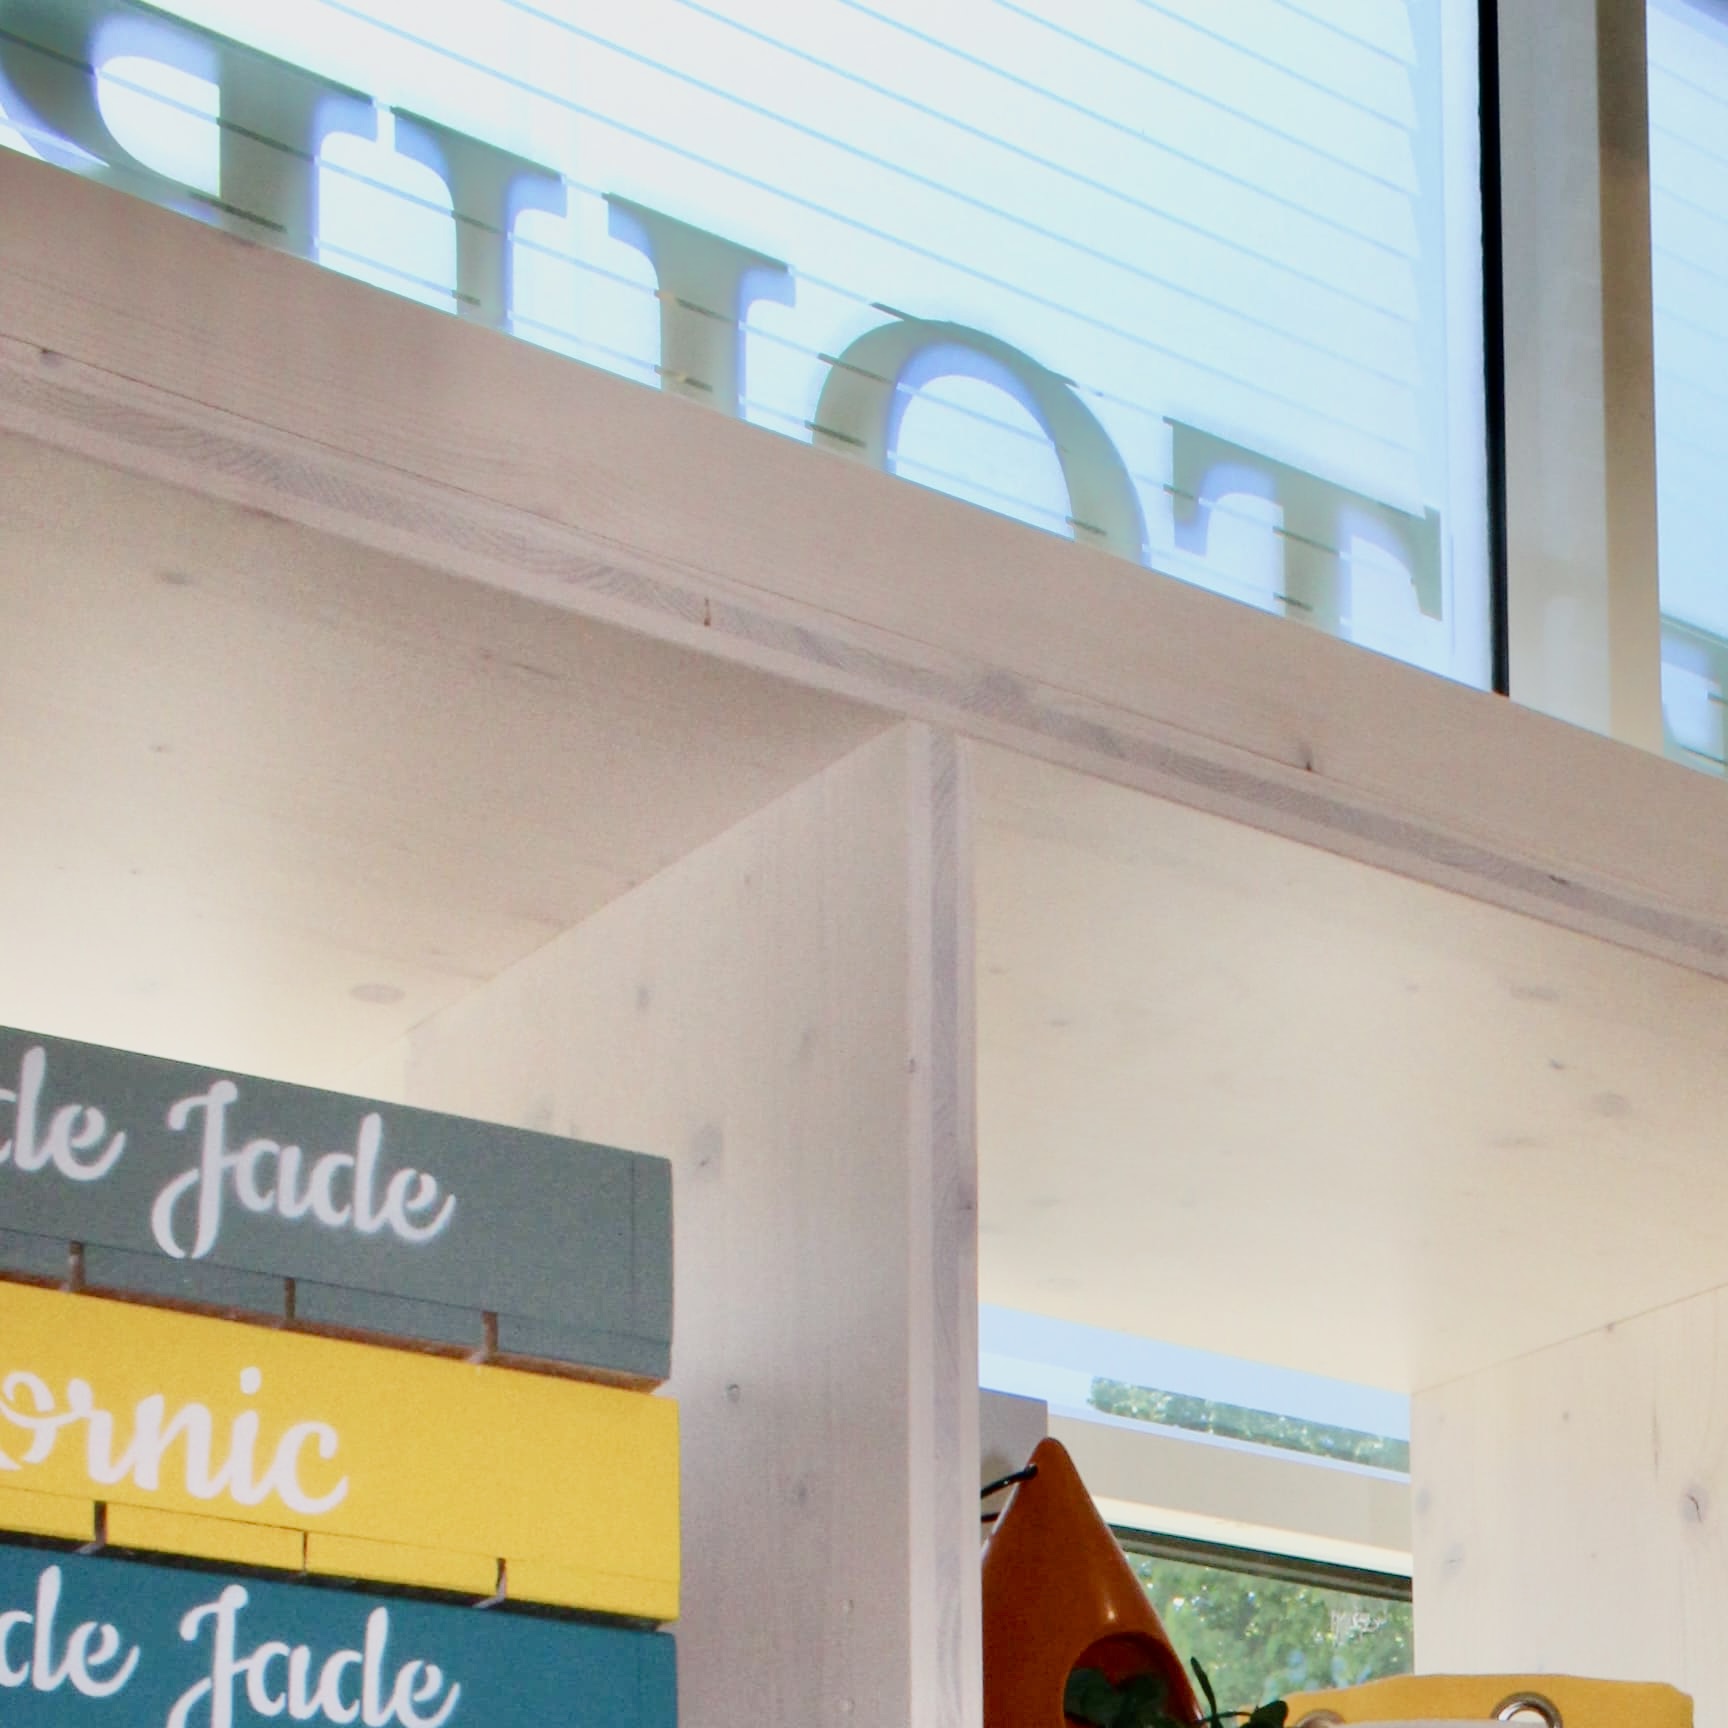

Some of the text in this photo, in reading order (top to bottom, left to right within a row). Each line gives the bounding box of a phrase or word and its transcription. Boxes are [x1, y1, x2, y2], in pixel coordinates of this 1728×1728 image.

[151, 1078, 457, 1260] Jade
[0, 1367, 350, 1517] ornic
[0, 1564, 139, 1698] de
